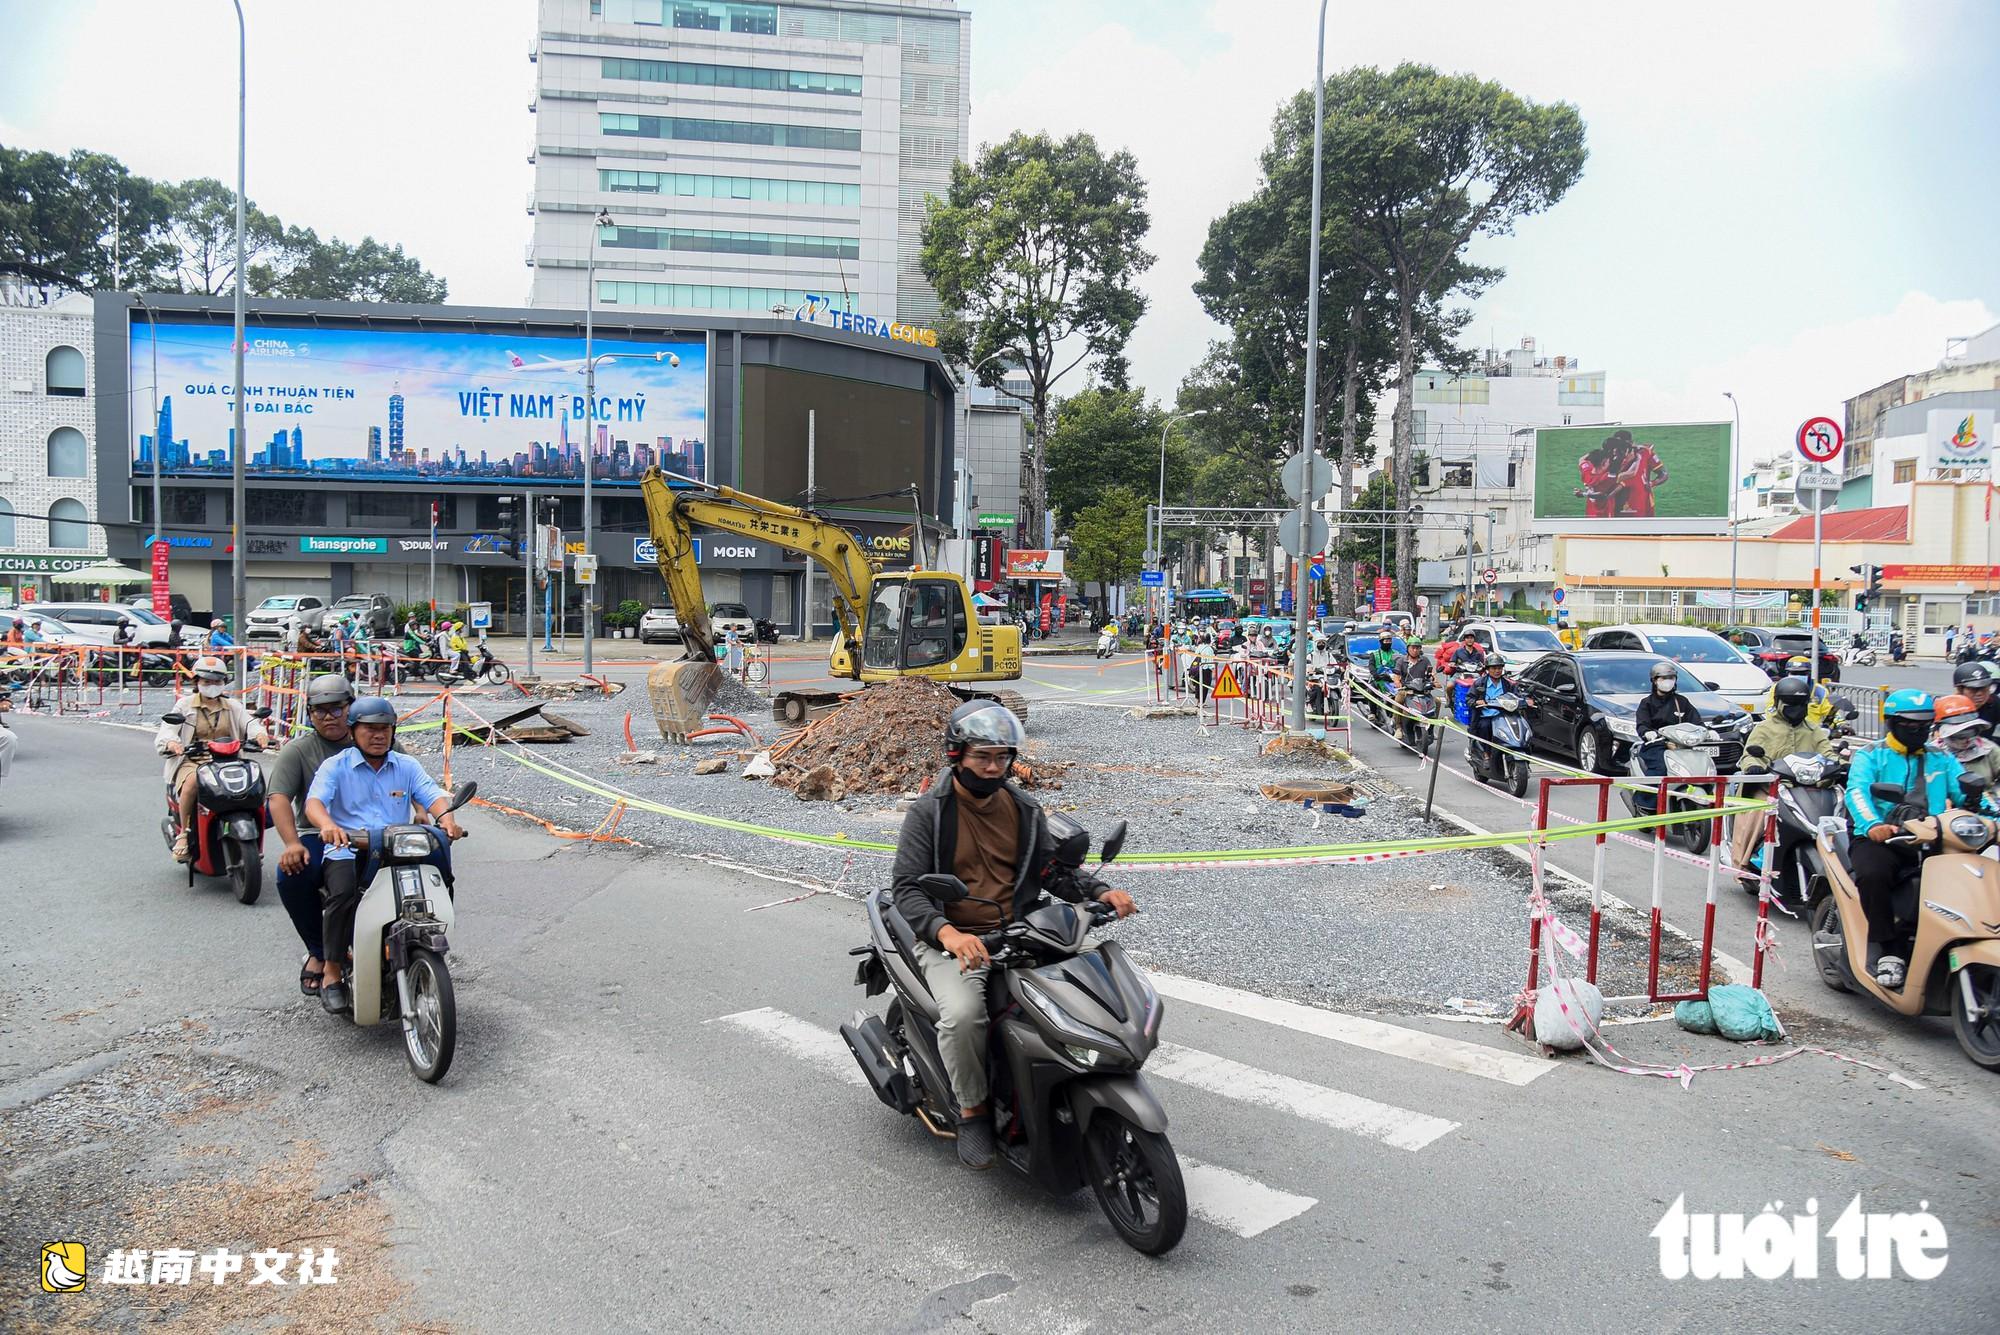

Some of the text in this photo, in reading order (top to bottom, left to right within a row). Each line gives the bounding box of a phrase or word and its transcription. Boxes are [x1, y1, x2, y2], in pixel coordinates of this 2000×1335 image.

[829, 309, 938, 348] TERRACONS
[254, 339, 289, 349] CHINA
[249, 348, 296, 358] AIRLINES
[185, 382, 216, 395] QUÁ
[268, 385, 318, 400] THUẬN
[323, 386, 355, 401] TIỆN
[227, 402, 249, 413] TI
[254, 400, 279, 413] ĐÀI
[458, 386, 504, 423] VIỆT
[510, 393, 554, 419] NAM
[618, 392, 646, 422] MỸ
[718, 517, 746, 529] KOMATSU
[309, 537, 377, 552] hansgrohe
[713, 546, 756, 558] MOEN
[39, 559, 49, 570] &
[994, 661, 1018, 670] PC120
